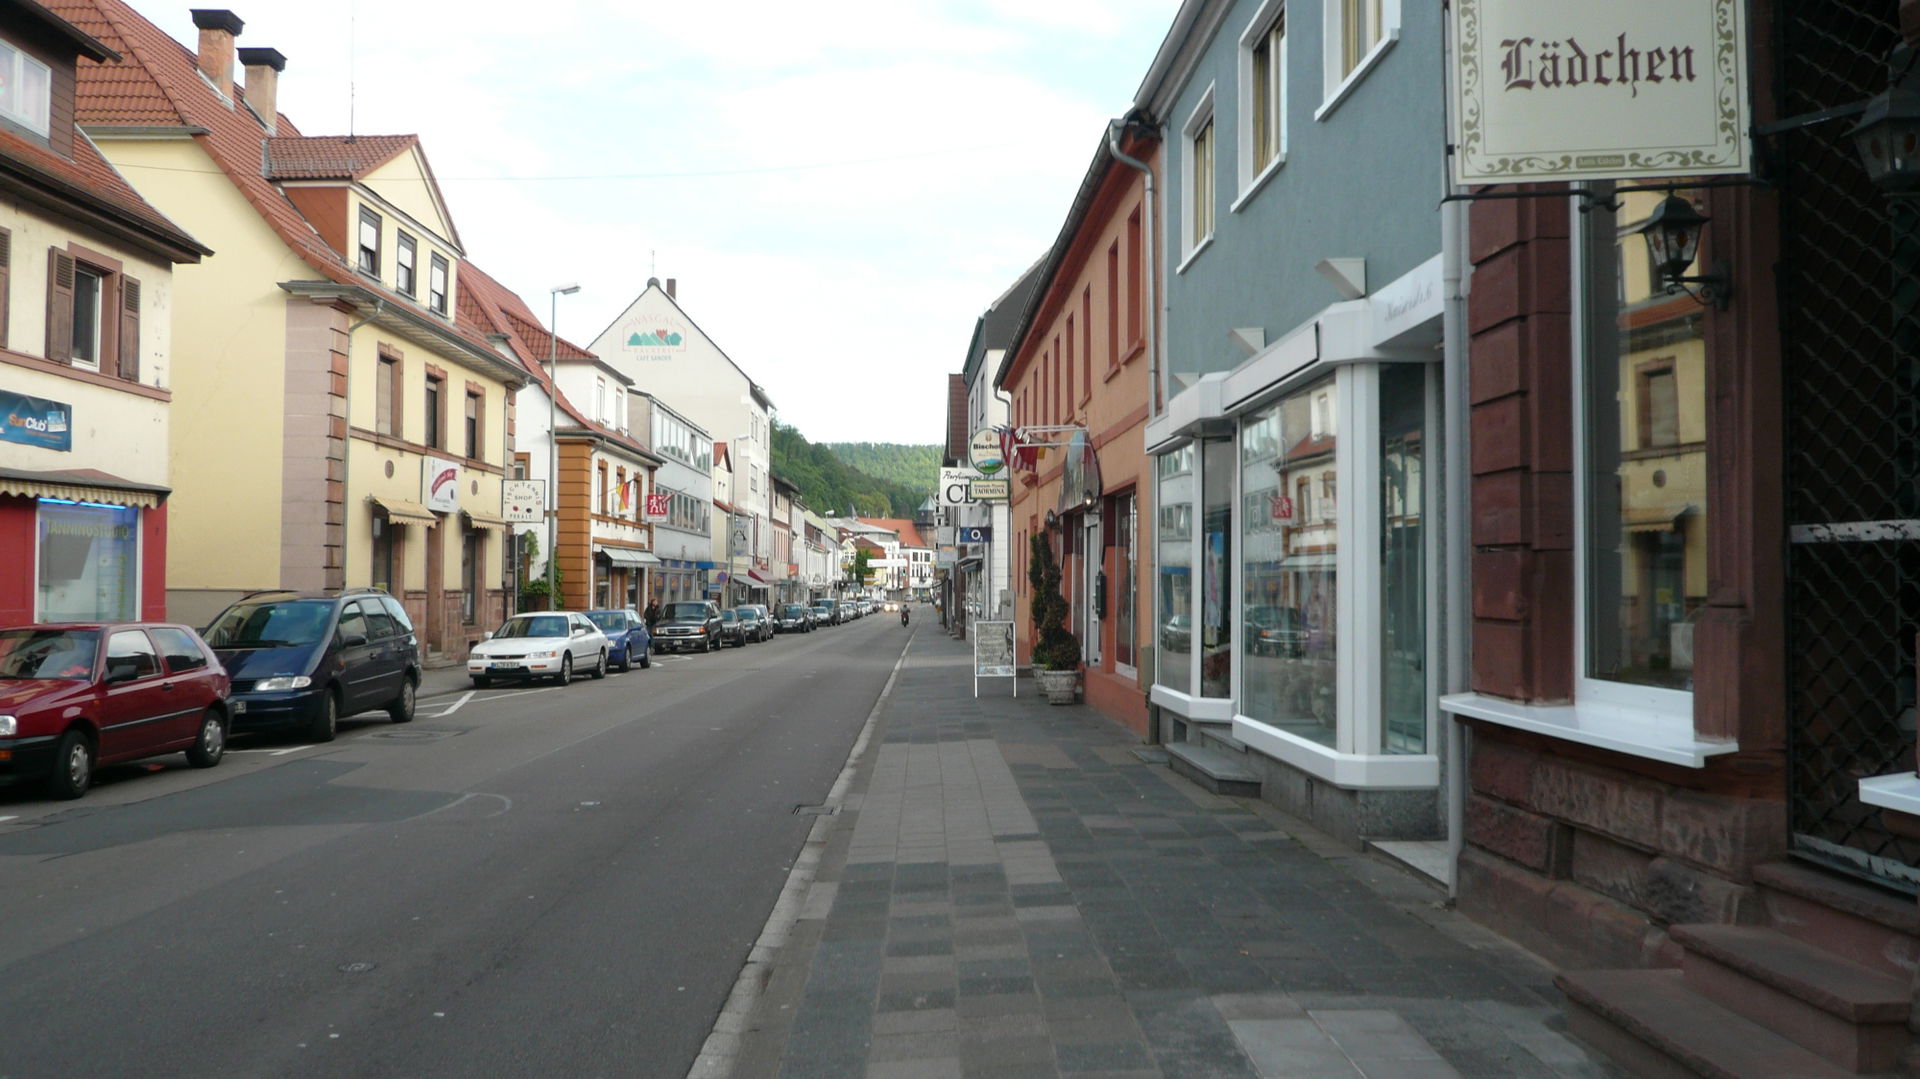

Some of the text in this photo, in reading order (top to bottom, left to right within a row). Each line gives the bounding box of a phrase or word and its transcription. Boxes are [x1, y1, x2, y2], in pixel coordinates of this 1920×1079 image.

[1500, 31, 1698, 99] Lädchen
[9, 414, 47, 431] SunClub
[46, 519, 129, 539] TANNINGSTUDIO
